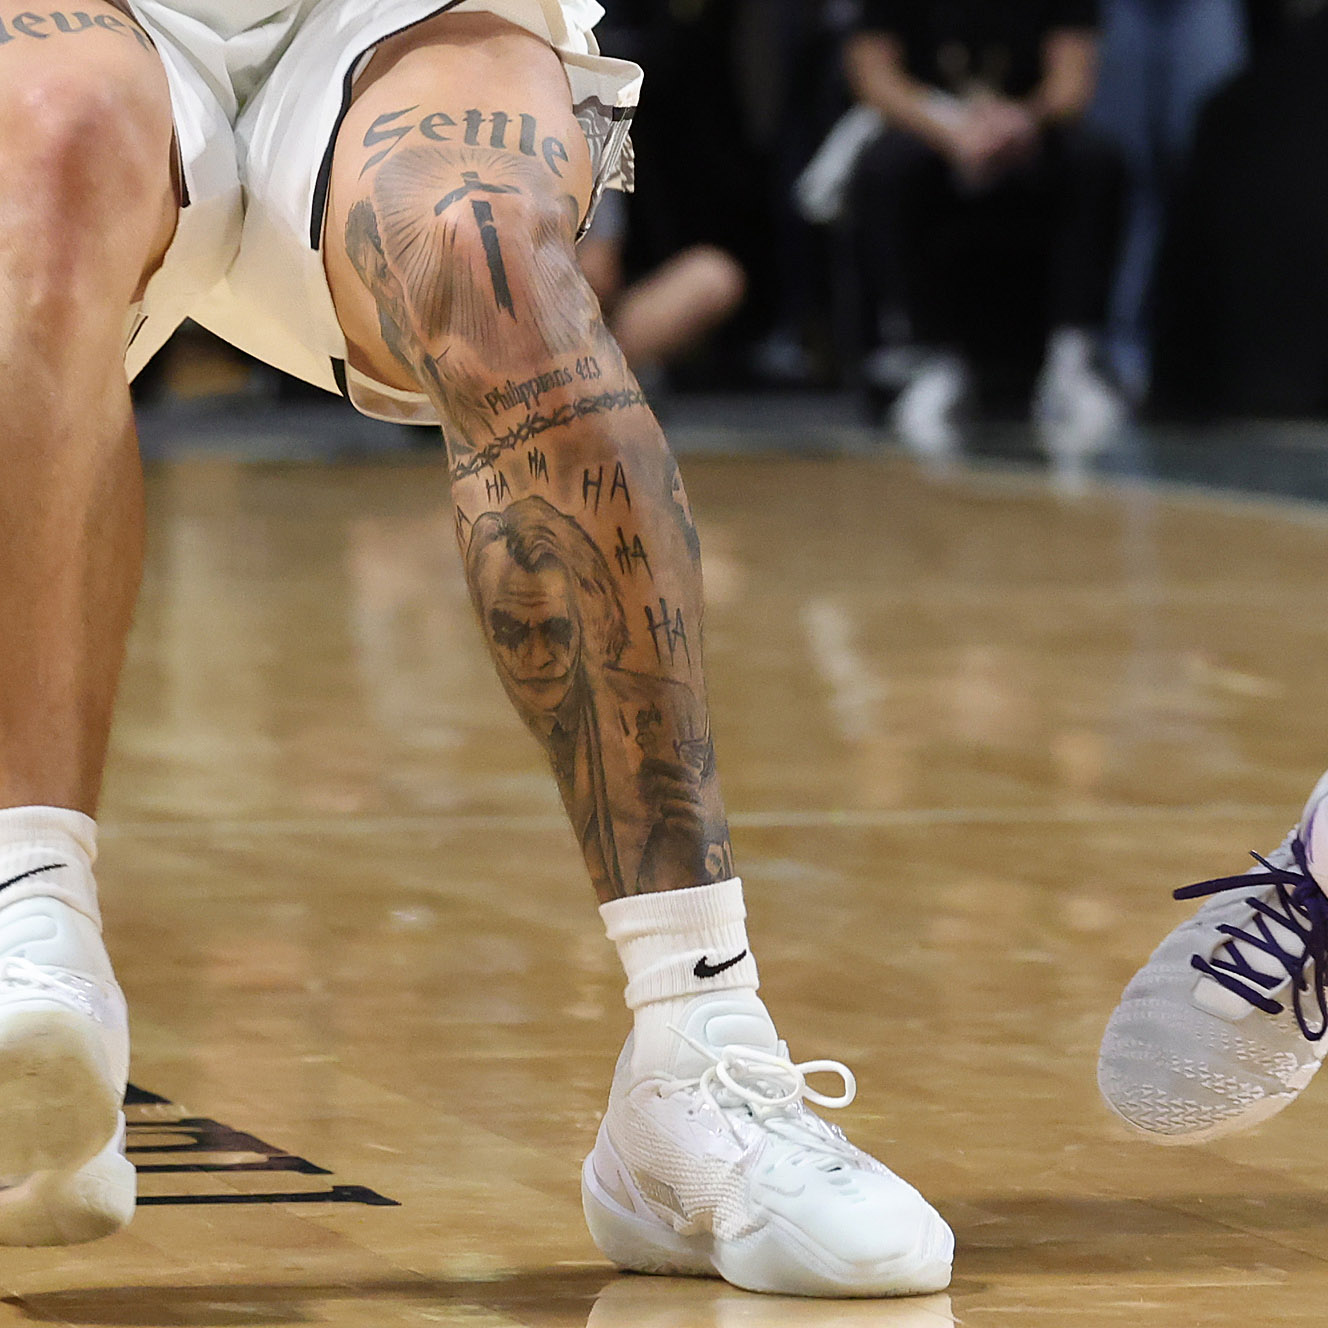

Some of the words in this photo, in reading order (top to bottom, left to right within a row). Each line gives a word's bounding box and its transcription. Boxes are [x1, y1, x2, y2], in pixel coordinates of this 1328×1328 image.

[360, 104, 569, 180] Settle
[485, 470, 513, 505] HA
[528, 447, 549, 484] HA
[581, 461, 632, 516] HA
[614, 526, 655, 582] HA
[644, 597, 693, 680] HA
